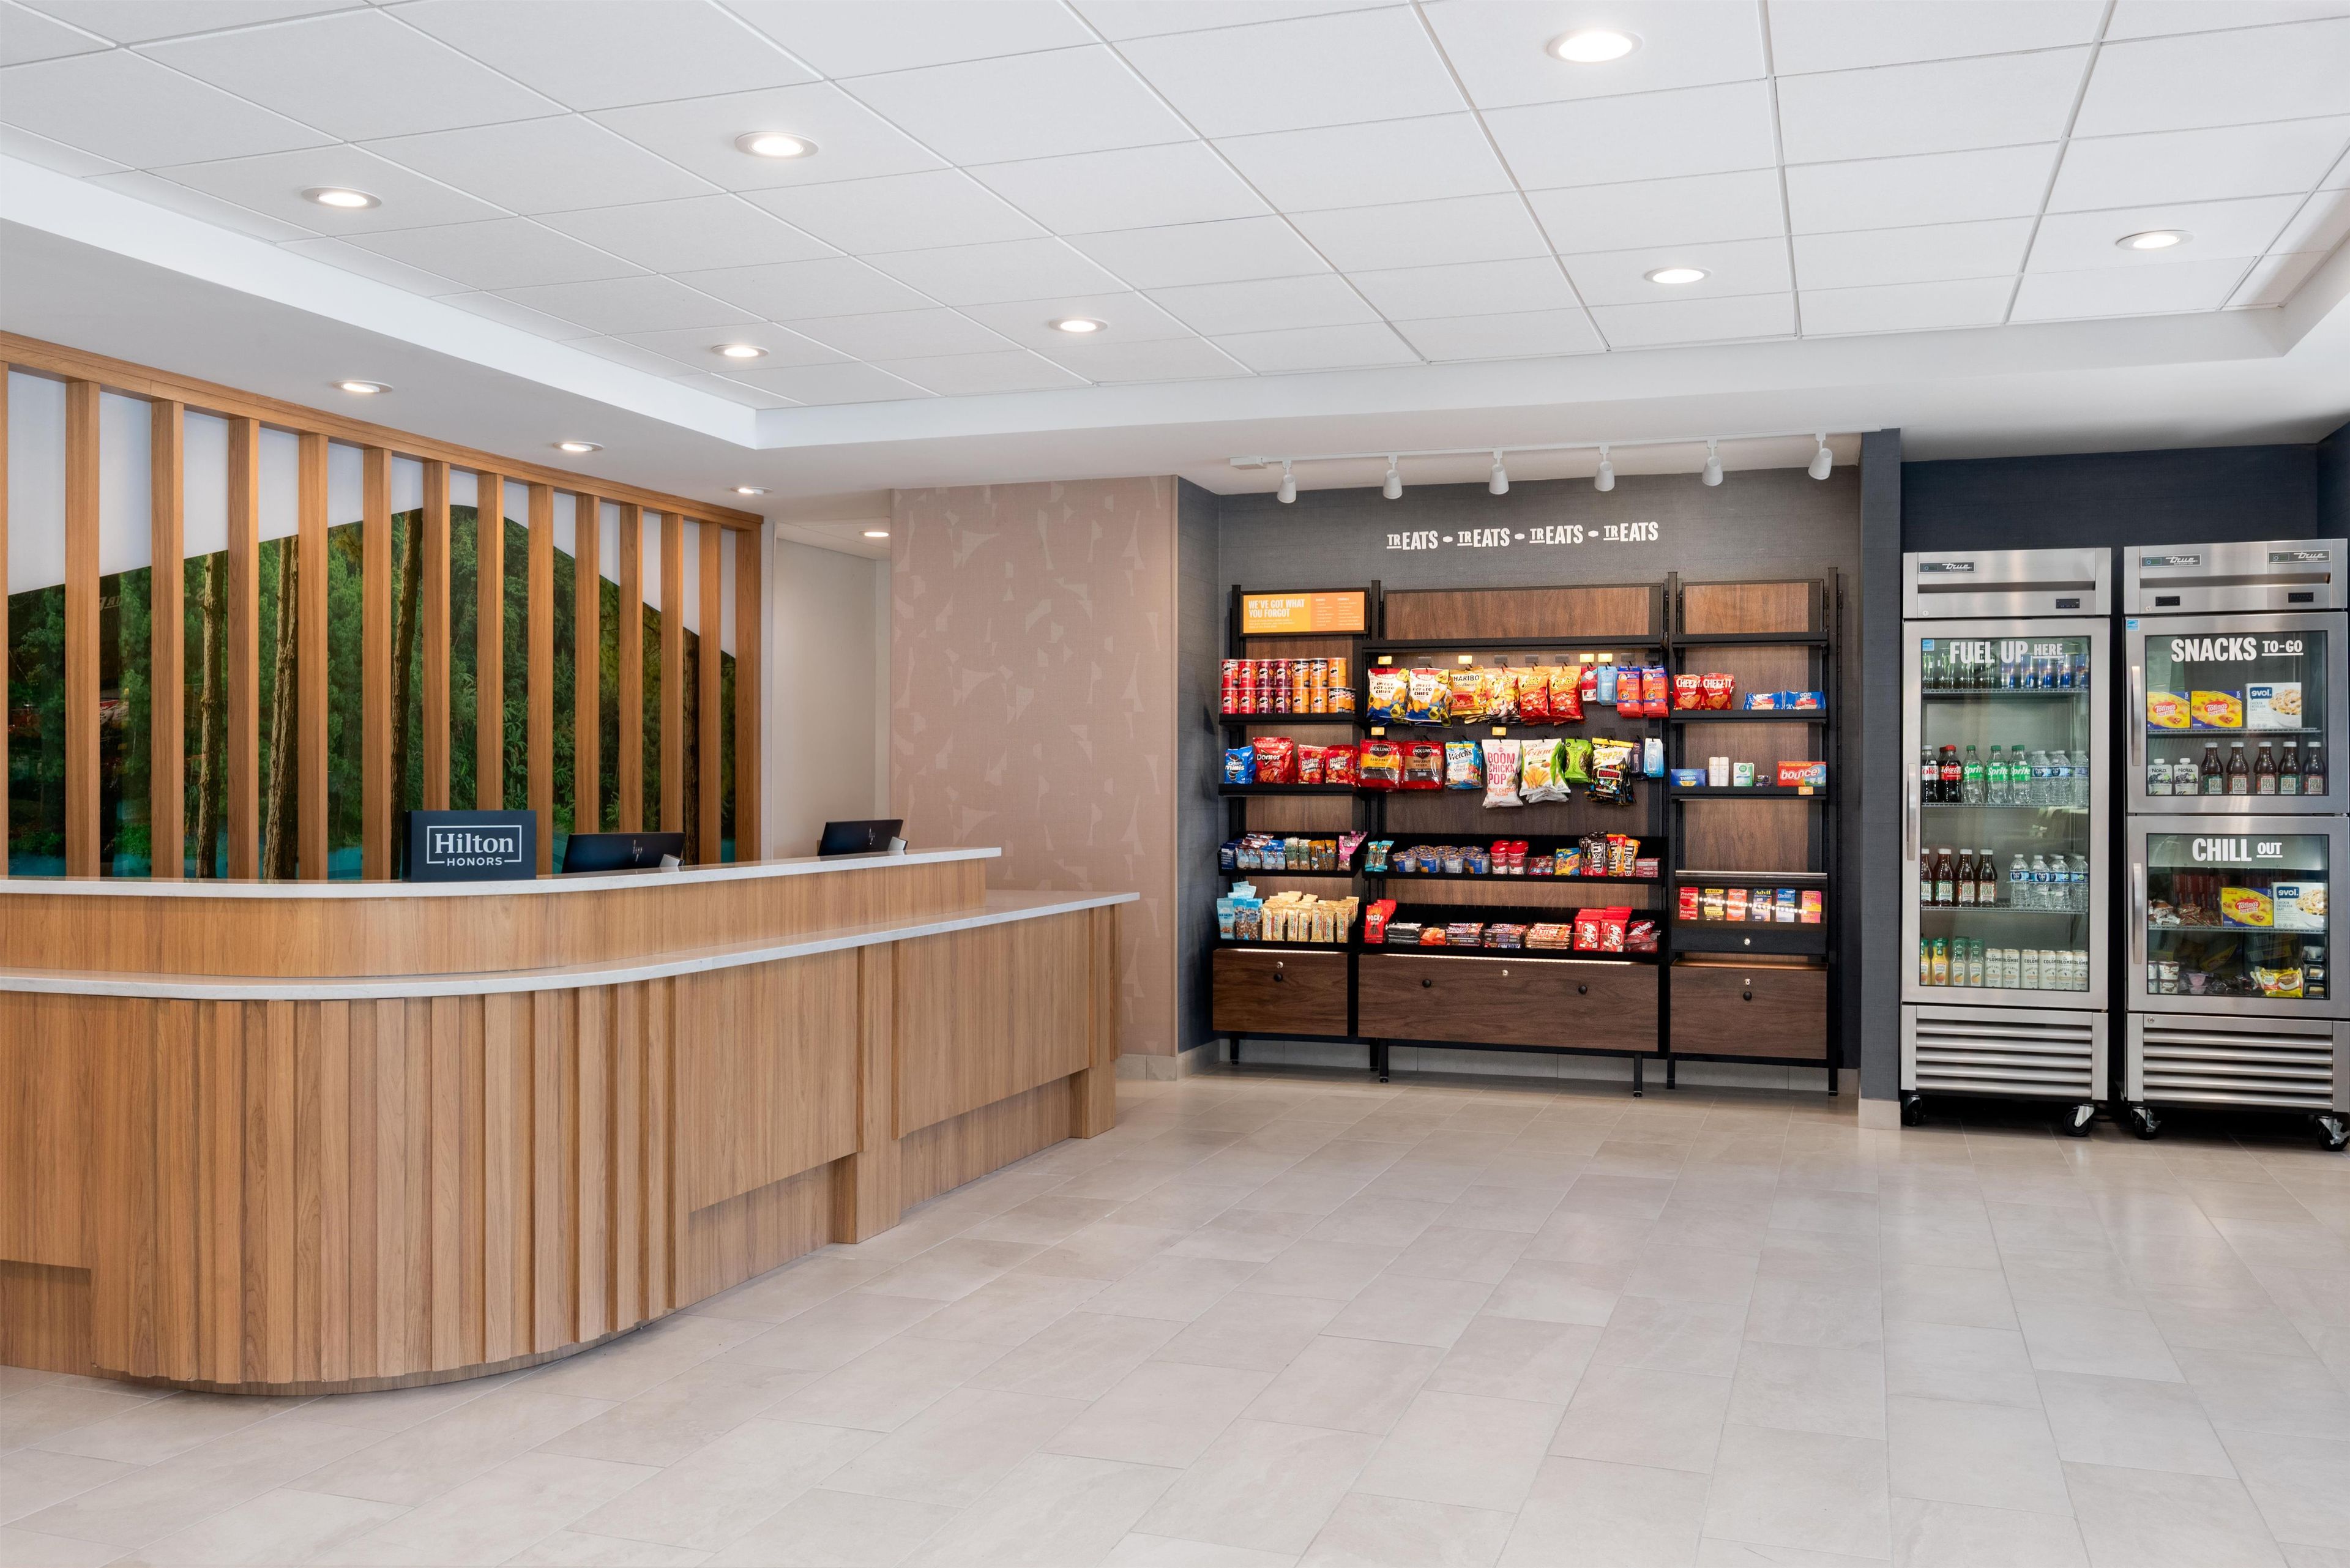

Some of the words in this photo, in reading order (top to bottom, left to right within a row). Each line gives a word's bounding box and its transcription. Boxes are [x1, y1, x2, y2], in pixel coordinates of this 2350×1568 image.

[1387, 531, 1438, 550] TREATS
[1457, 528, 1510, 547] TREATS
[1529, 525, 1583, 545] TREATS
[1603, 521, 1658, 542] TREATS
[1248, 600, 1269, 609] WE'VE
[1270, 599, 1284, 608] GOT
[1286, 599, 1305, 608] WHAT
[1249, 609, 1263, 618] YOU
[1264, 608, 1290, 618] FORGOT
[1950, 641, 1995, 664] FUEL
[2001, 641, 2029, 663] UP
[2034, 643, 2063, 655] HERE
[2171, 637, 2257, 662] SNACKS
[2262, 640, 2303, 653] TO-GO
[1449, 749, 1472, 760] Welch's
[1488, 752, 1515, 764] BOOM
[1489, 763, 1515, 773] CHICKA
[1488, 773, 1506, 785] POP
[1781, 769, 1818, 780] bounce
[435, 833, 514, 854] Hilton
[2192, 838, 2252, 862] CHILL
[2257, 842, 2282, 855] OUT
[447, 857, 502, 867] HONORS
